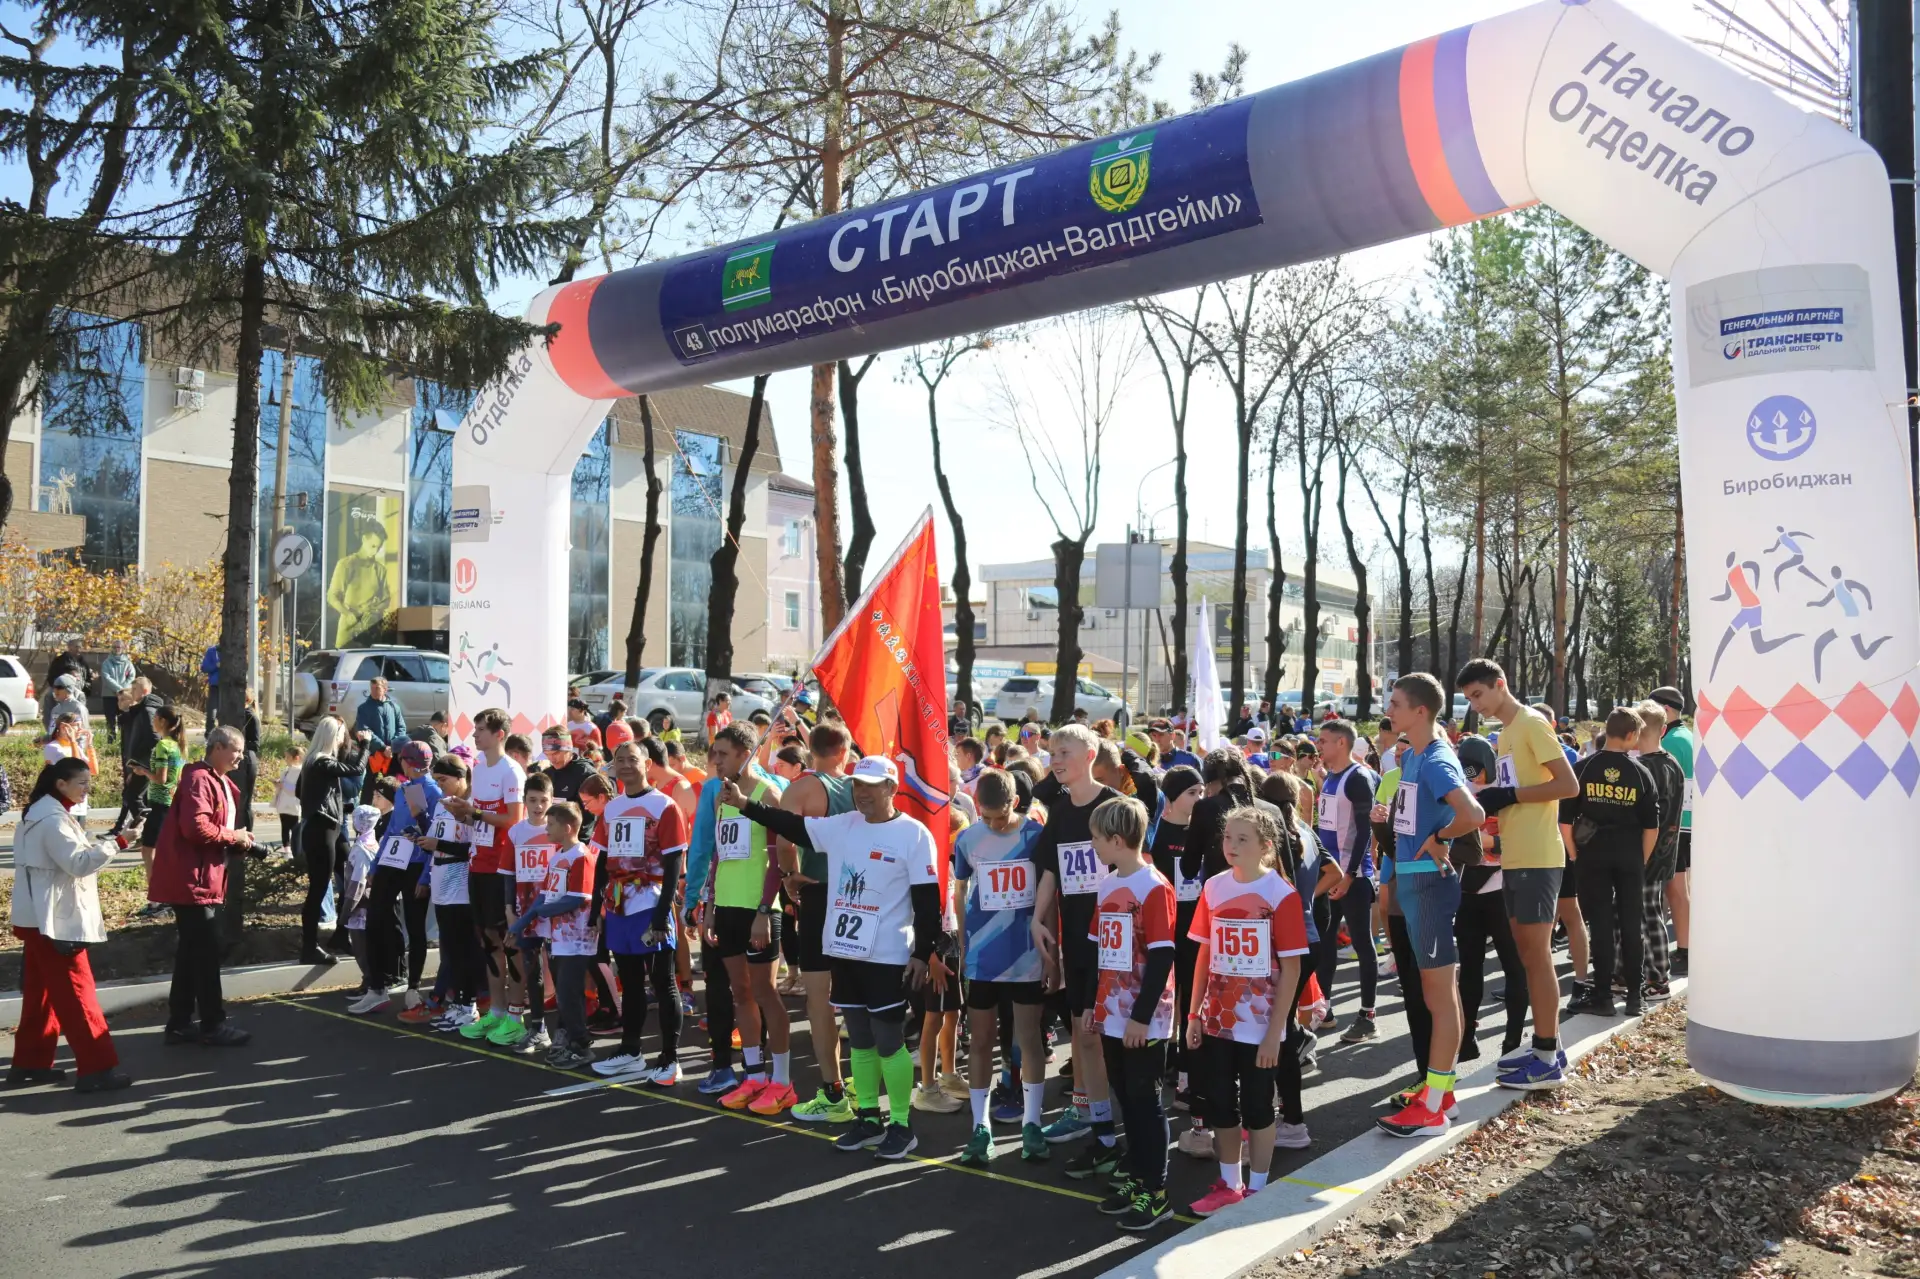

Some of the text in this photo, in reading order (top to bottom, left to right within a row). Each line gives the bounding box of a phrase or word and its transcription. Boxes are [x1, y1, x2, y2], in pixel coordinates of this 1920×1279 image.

[1581, 42, 1755, 156] Начало
[1549, 81, 1718, 206] Отделка
[829, 168, 1035, 273] СТАРТ
[686, 192, 1242, 351] 43 полумарафон «Биробиджан-Валдгейм»
[1723, 310, 1840, 331] ГЕНЕРАЛЬНЫЙ ПАРТНЁР
[1747, 332, 1843, 348] ТРАНСНЕФТЬ
[1748, 344, 1821, 357] ДАЛЬНИЙ ВОСТОК
[471, 355, 533, 445] Отделка
[1723, 472, 1852, 495] Биробиджан
[281, 548, 303, 566] 20
[1586, 783, 1637, 801] RUSSIA
[615, 822, 631, 842] 81
[721, 822, 738, 845] 80
[390, 840, 400, 855] 8
[520, 850, 548, 868] 164
[1063, 848, 1097, 876] 241
[988, 866, 1026, 892] 170
[835, 913, 863, 940] 82
[1215, 926, 1259, 957] 155
